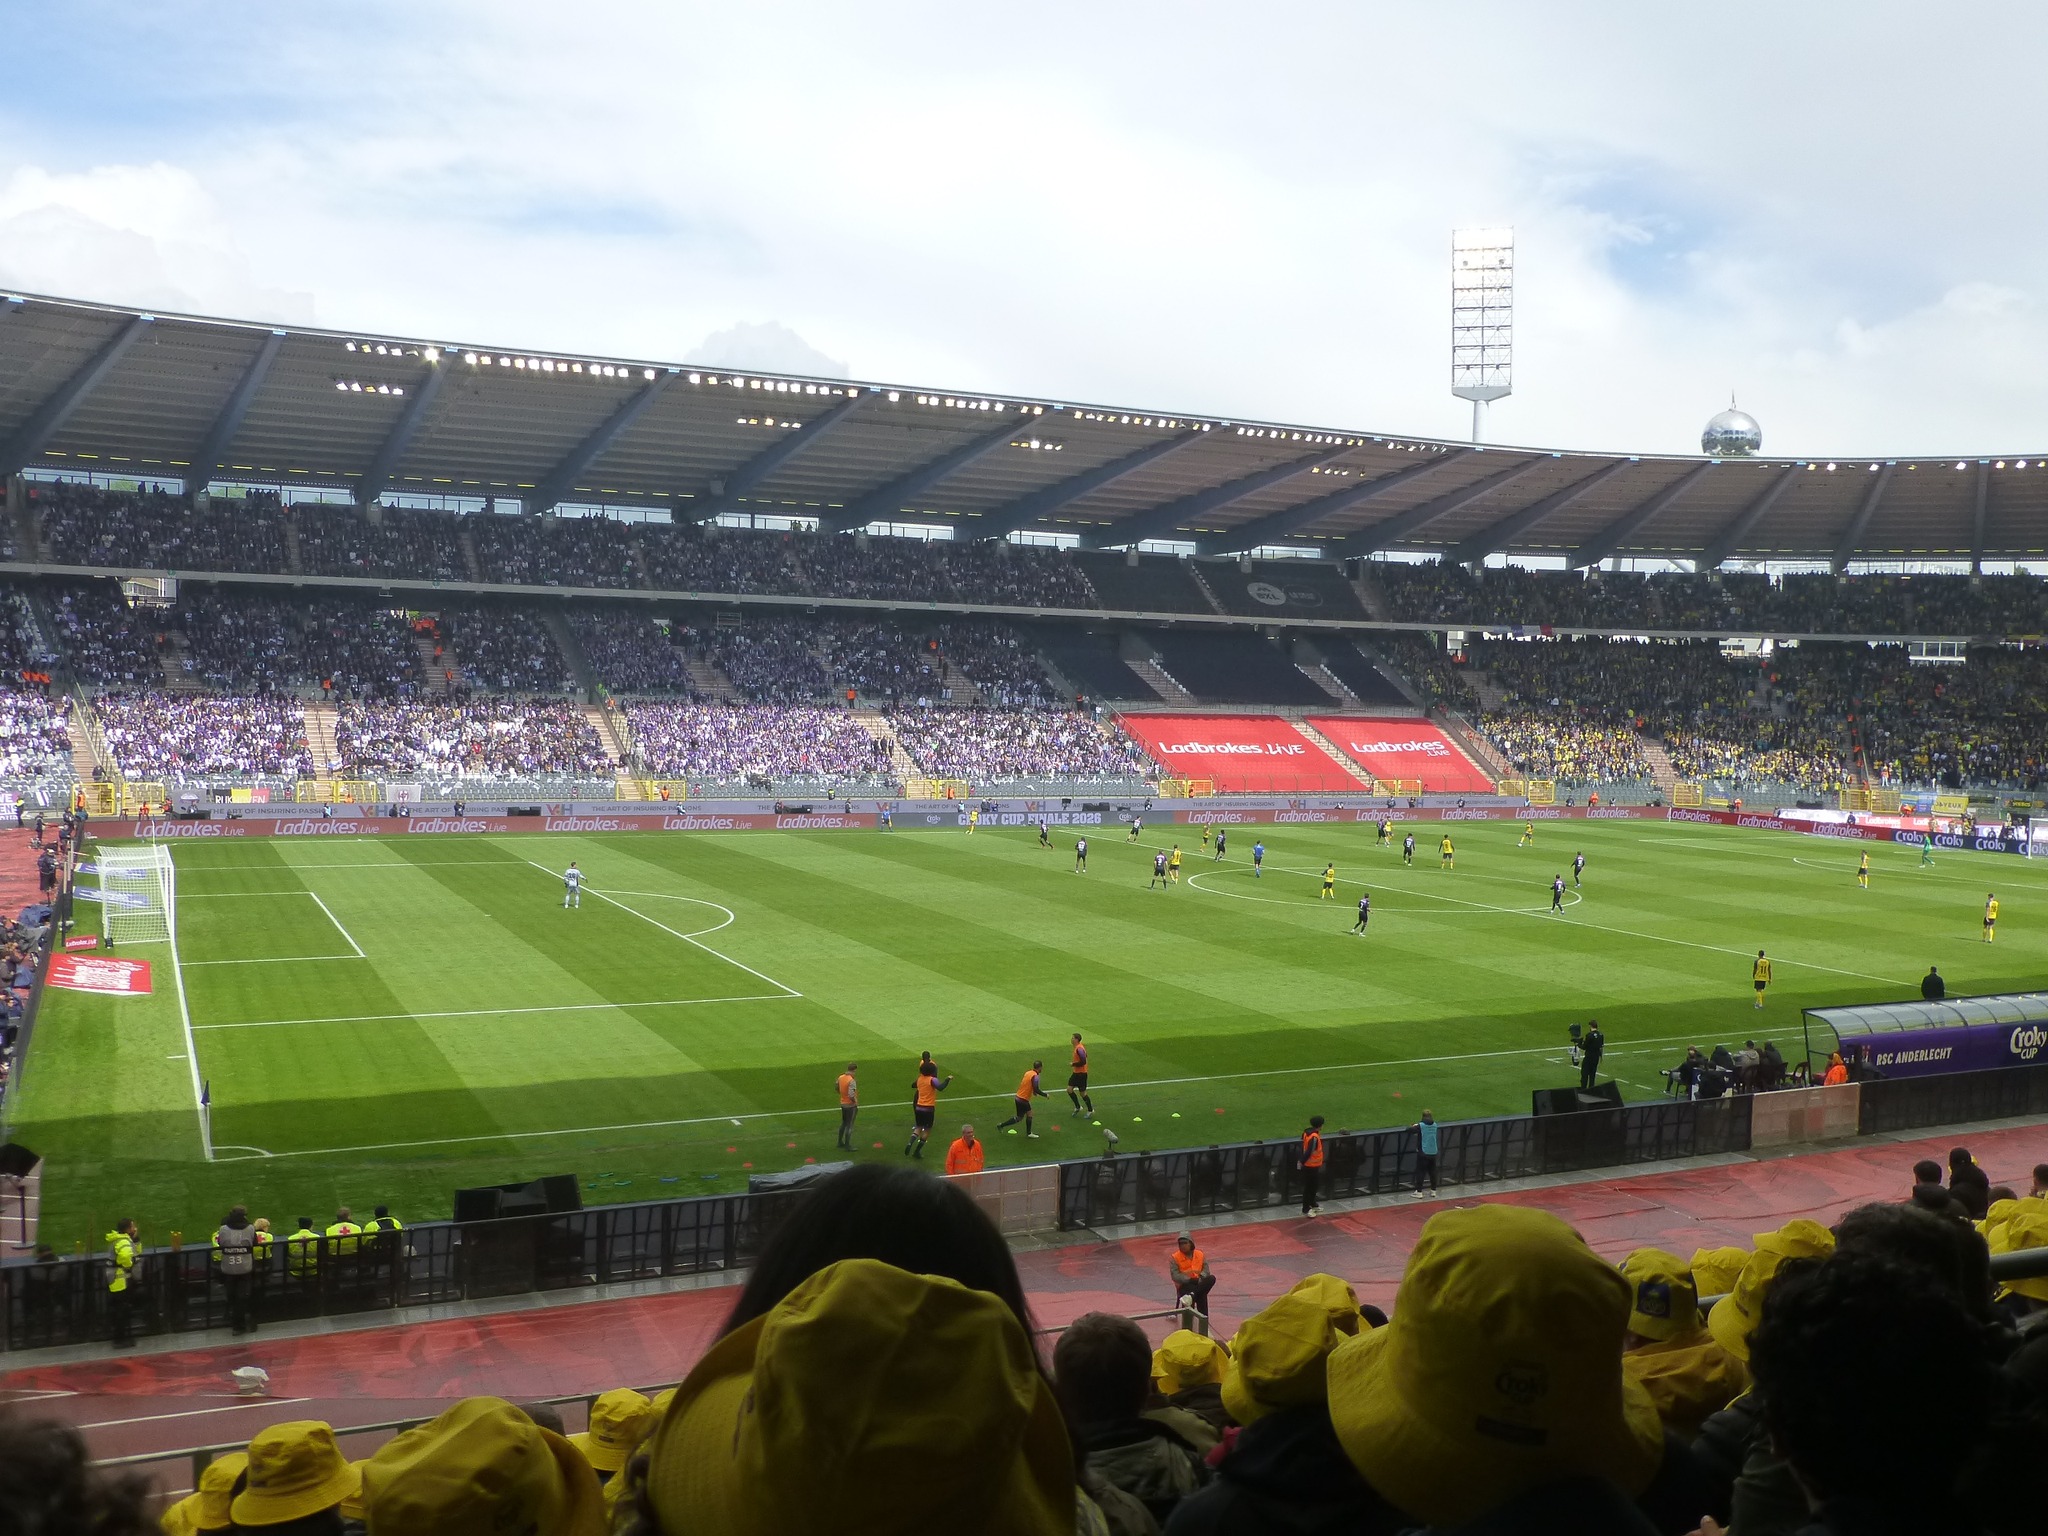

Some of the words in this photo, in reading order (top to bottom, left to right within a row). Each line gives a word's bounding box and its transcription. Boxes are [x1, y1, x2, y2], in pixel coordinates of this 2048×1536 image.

[1350, 740, 1445, 753] Ladbrokes
[257, 807, 297, 815] INSURING
[1001, 813, 1025, 826] CUP
[1028, 812, 1070, 825] FINALE
[1074, 812, 1102, 824] 2026
[1895, 829, 1925, 846] Croky
[1934, 831, 1964, 848] Croky
[1975, 837, 2007, 852] Croky
[2010, 1025, 2048, 1054] Croky
[1876, 1052, 1894, 1066] RSC
[1894, 1047, 1953, 1064] ANDERLECHT
[2020, 1047, 2039, 1060] CUP
[229, 1255, 243, 1266] 33
